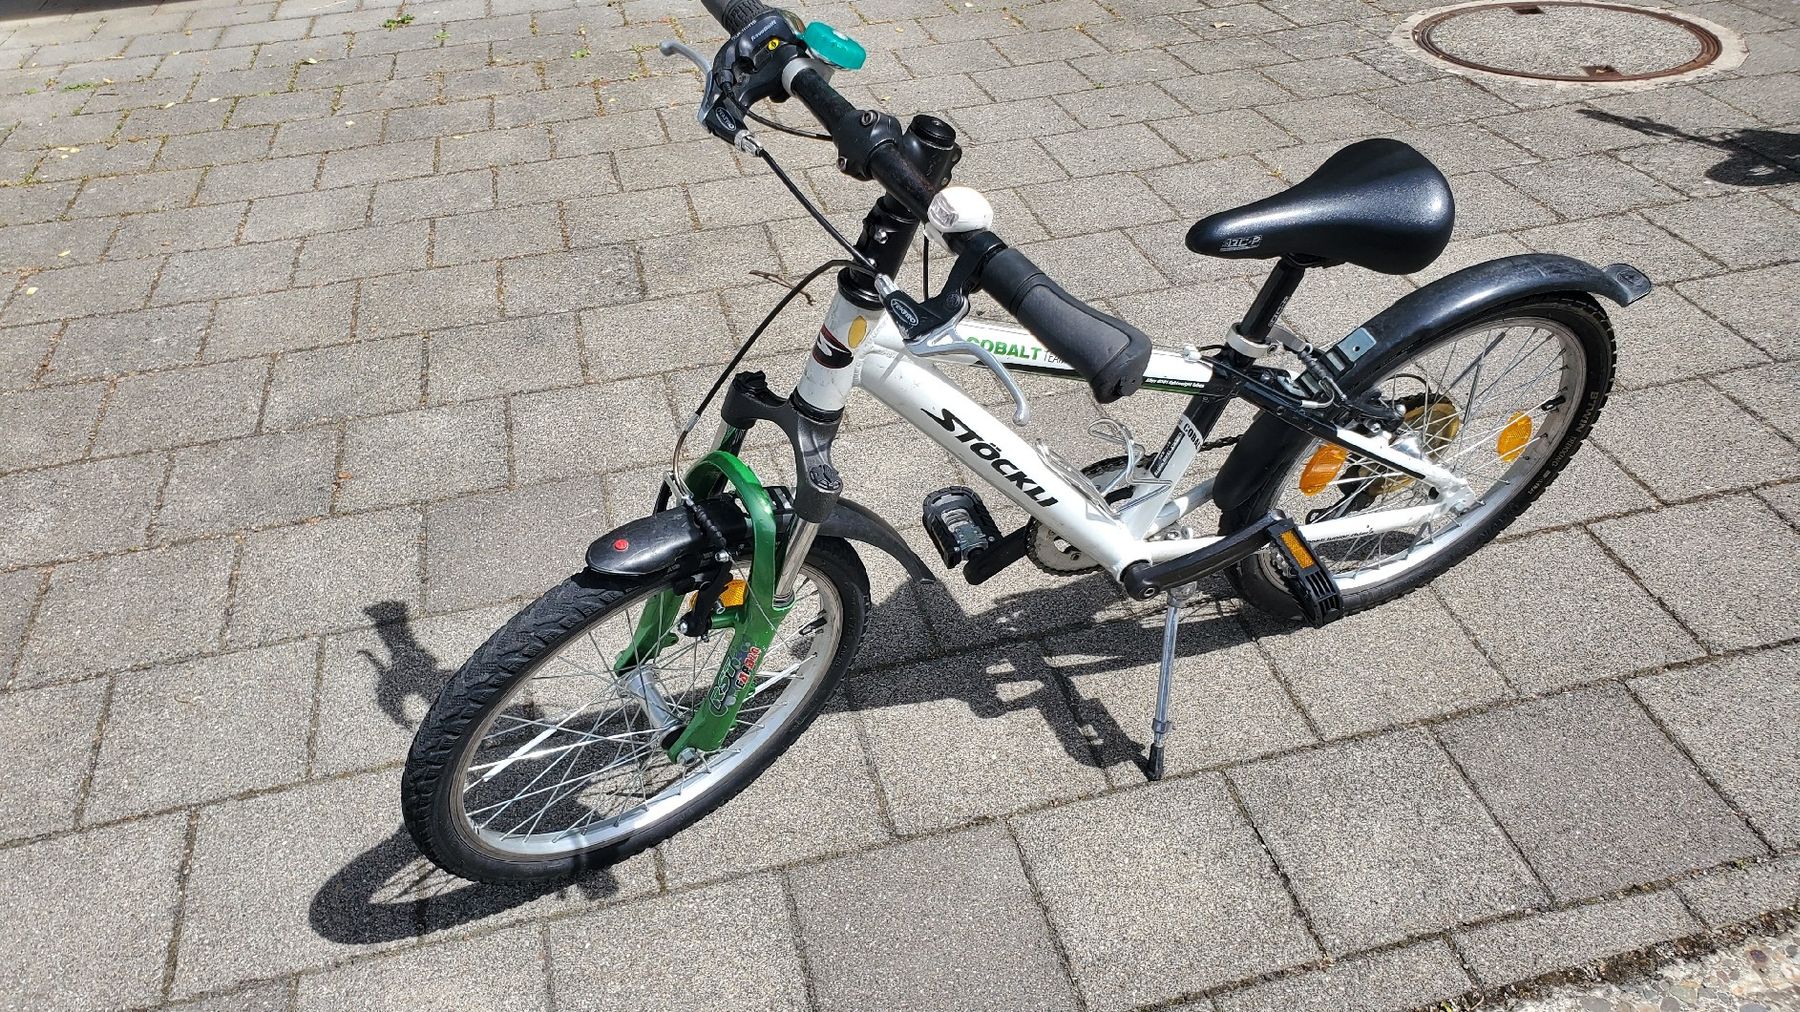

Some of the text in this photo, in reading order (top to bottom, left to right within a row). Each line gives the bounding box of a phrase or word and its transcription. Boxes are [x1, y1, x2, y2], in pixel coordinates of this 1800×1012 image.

[920, 407, 1059, 508] STÖCKLI
[1182, 422, 1201, 451] COBAL
[709, 656, 736, 710] RST
